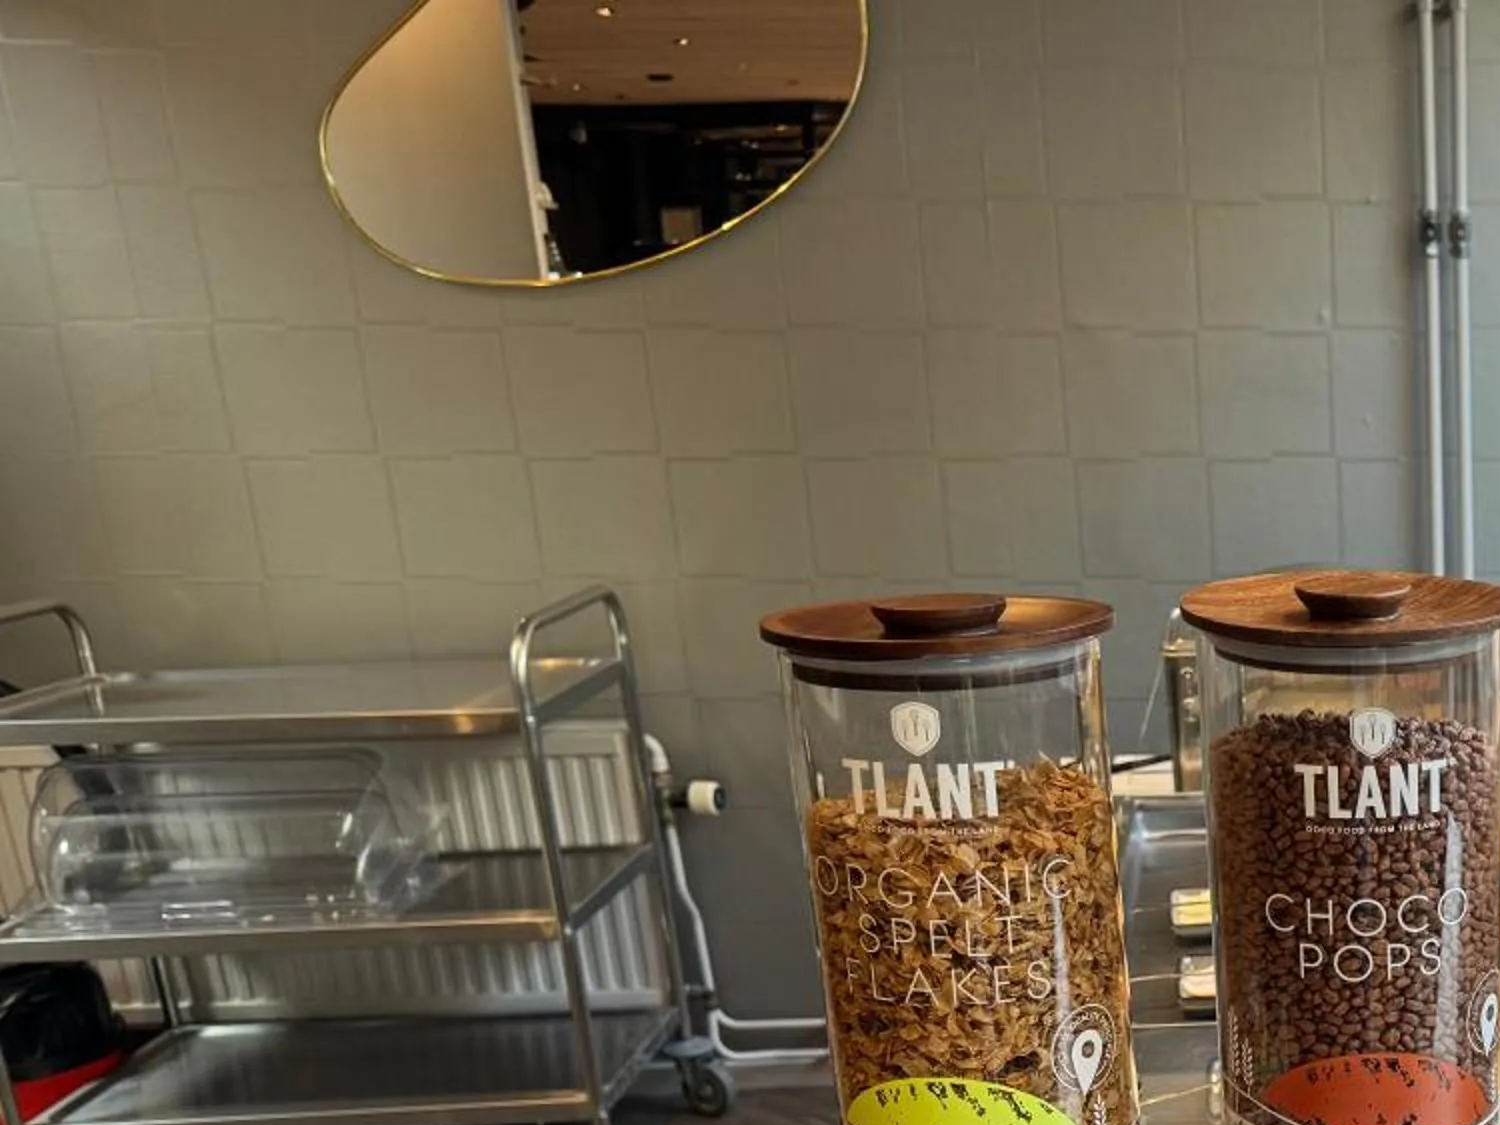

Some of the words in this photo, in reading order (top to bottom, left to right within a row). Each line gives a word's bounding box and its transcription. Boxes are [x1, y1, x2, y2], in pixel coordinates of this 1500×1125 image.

[841, 757, 1005, 820] TLANT
[1294, 757, 1450, 819] TLANT
[816, 855, 1073, 909] ORGANIC
[858, 913, 1023, 959] SPELT
[1265, 887, 1468, 937] CHOCO
[845, 957, 1051, 1007] FLAKES
[1299, 938, 1441, 983] POPS
